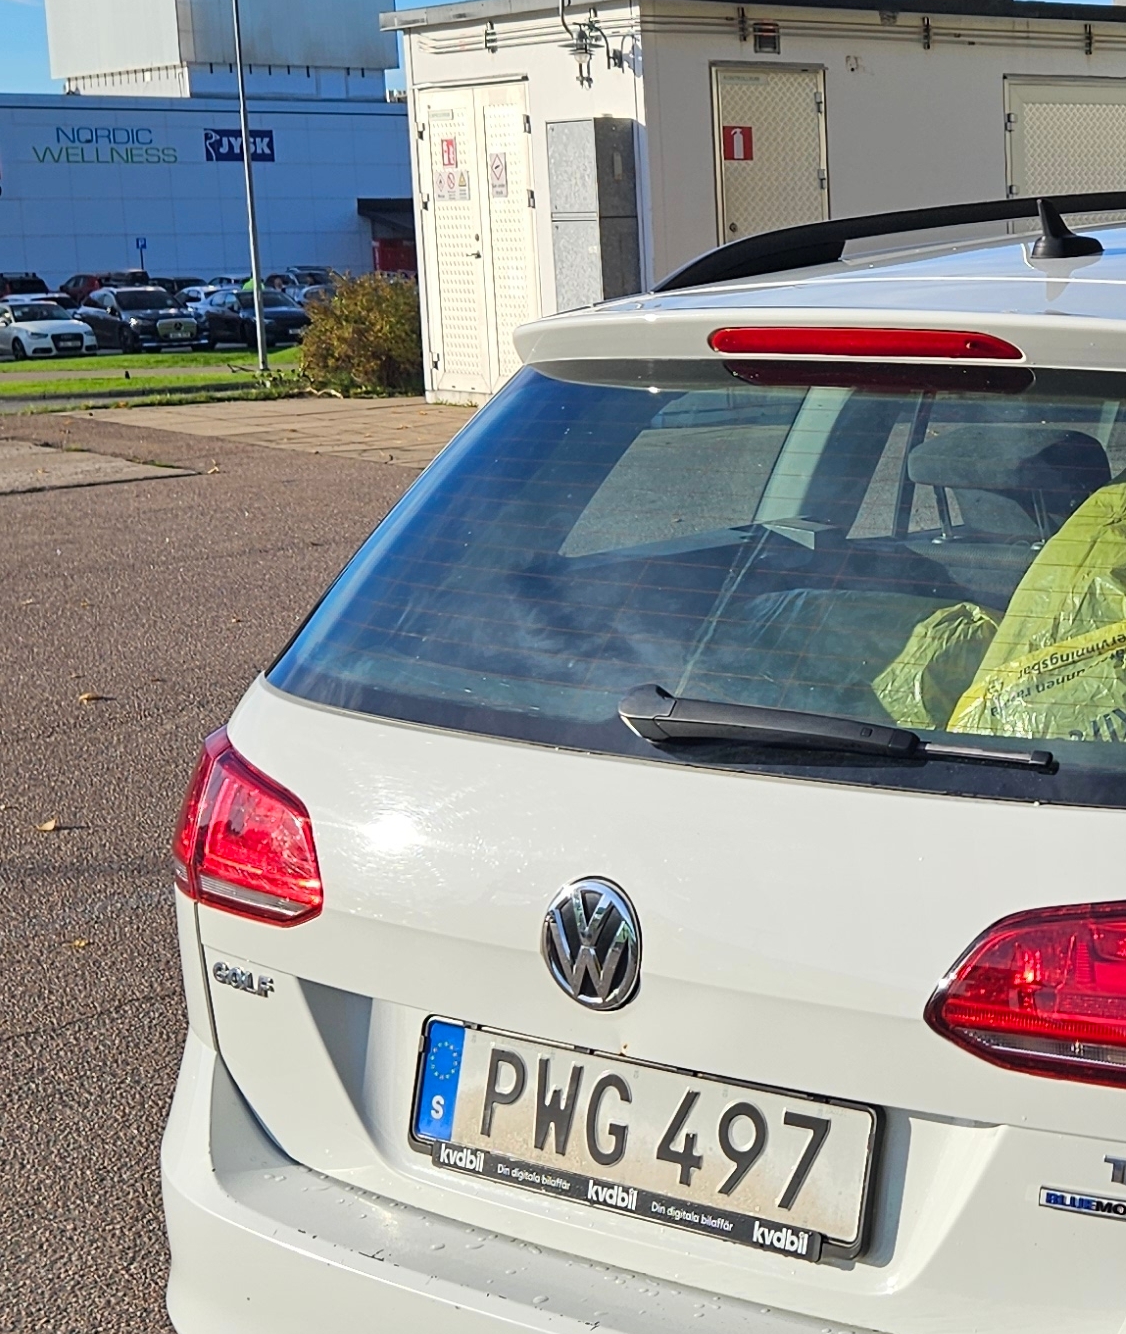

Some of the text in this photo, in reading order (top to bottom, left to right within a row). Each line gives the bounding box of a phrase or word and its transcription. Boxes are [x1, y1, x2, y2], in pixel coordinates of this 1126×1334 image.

[55, 126, 153, 145] NORDIC
[219, 137, 271, 154] JYSK
[32, 146, 178, 164] WELLNESS
[212, 960, 275, 998] GOLF
[430, 1094, 445, 1121] S
[480, 1044, 831, 1211] PWG 497
[439, 1143, 485, 1173] kvdbil
[497, 1163, 571, 1191] Din digitala bilaffär
[587, 1179, 638, 1210] kvdbil
[651, 1200, 734, 1232] Din digitala bilaffär
[752, 1220, 810, 1255] kvdbil
